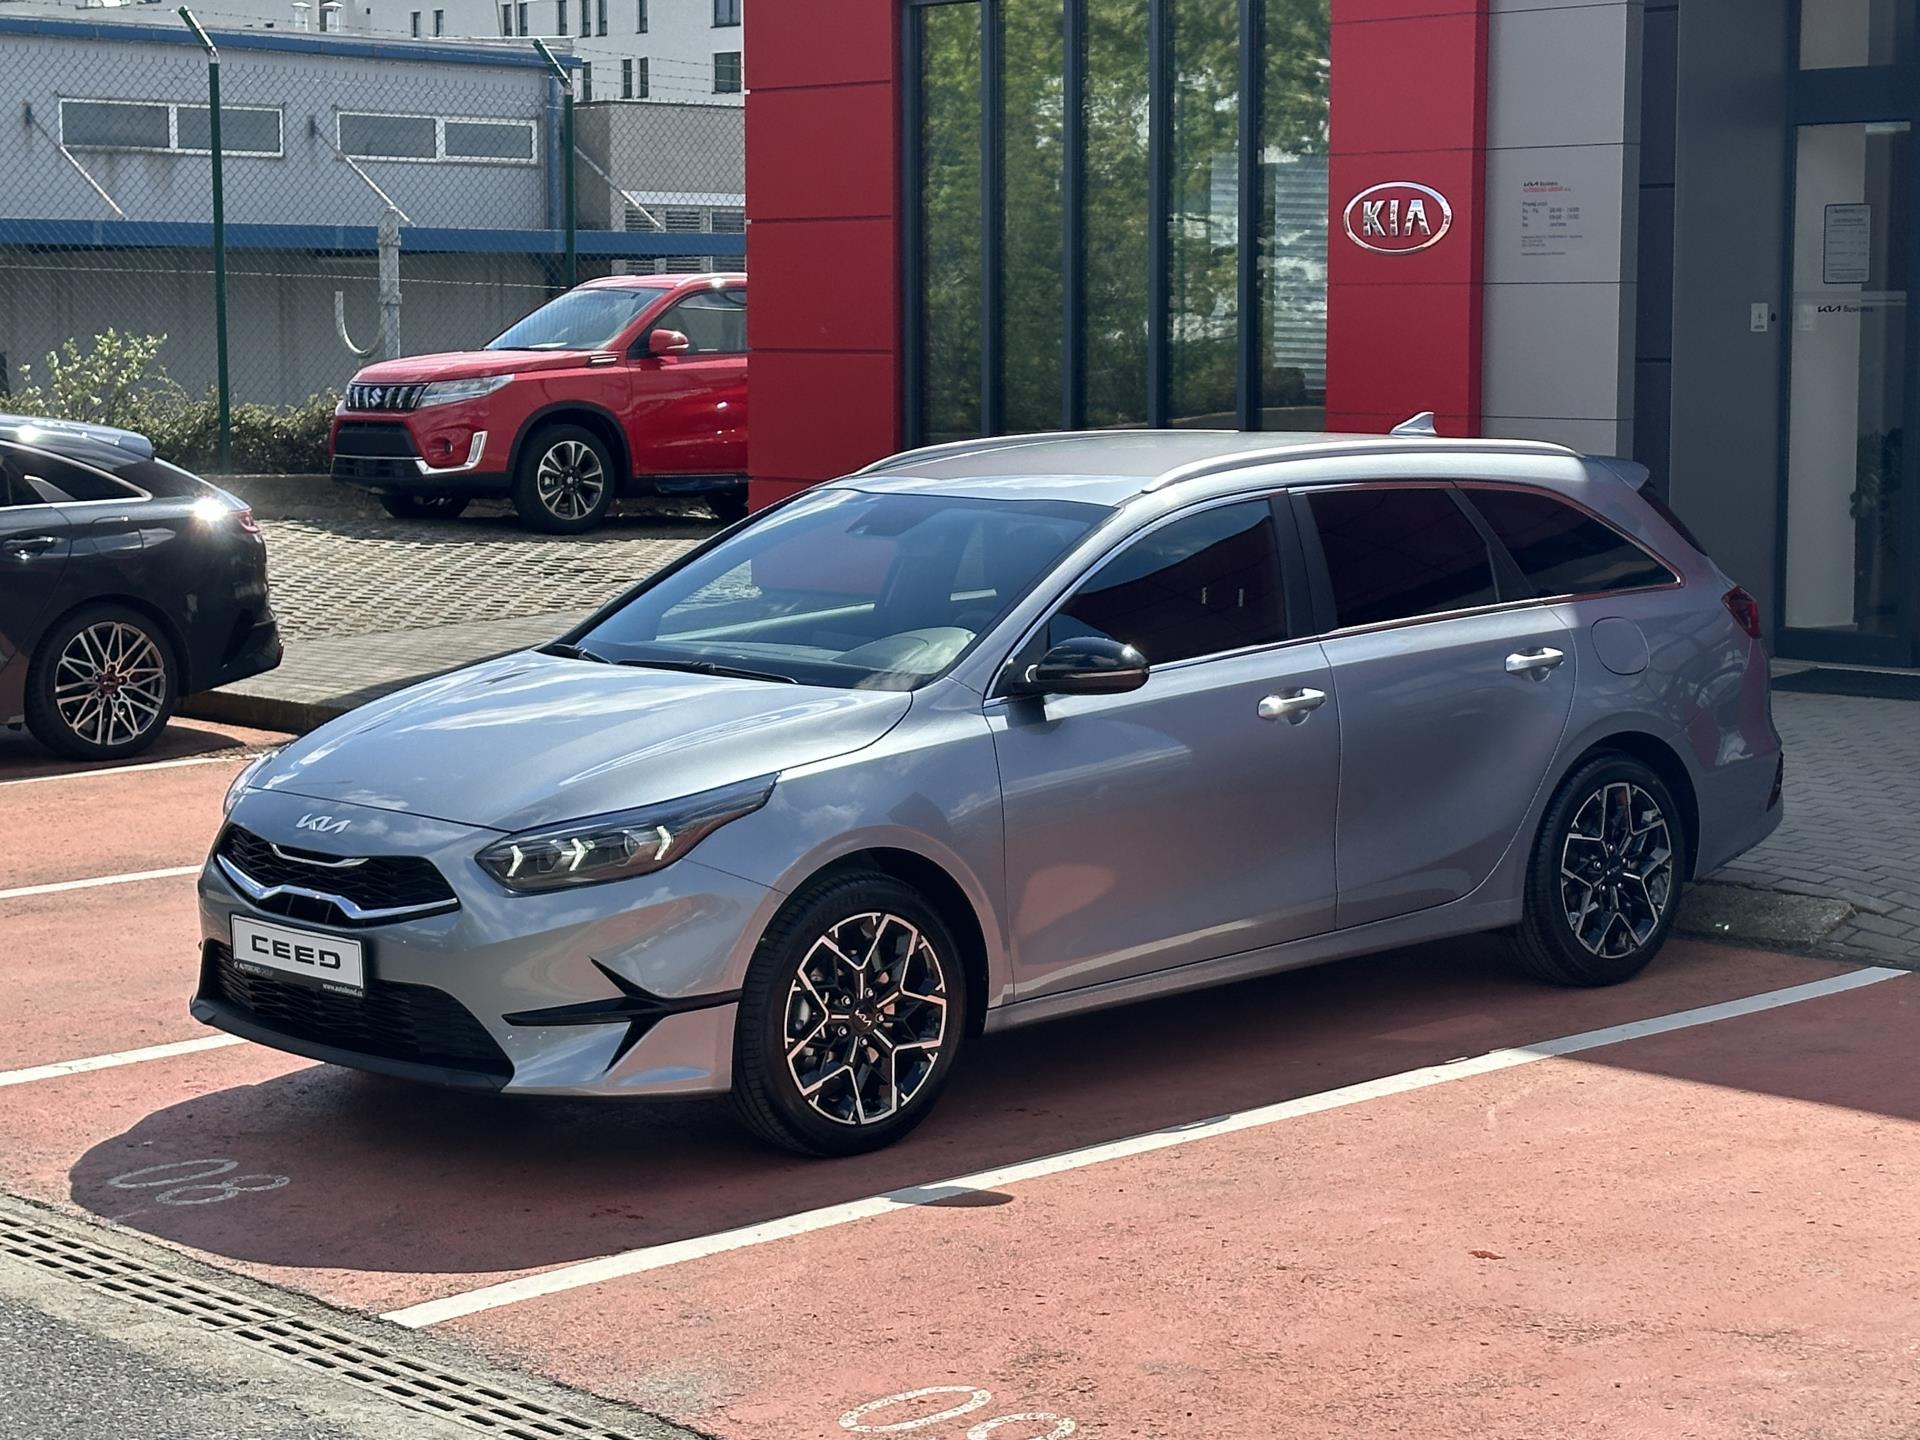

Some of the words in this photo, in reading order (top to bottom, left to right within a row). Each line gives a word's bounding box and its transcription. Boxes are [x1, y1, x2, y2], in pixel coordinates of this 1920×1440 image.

[1362, 199, 1431, 236] KIA
[295, 812, 351, 834] KIA
[251, 934, 341, 970] CEED
